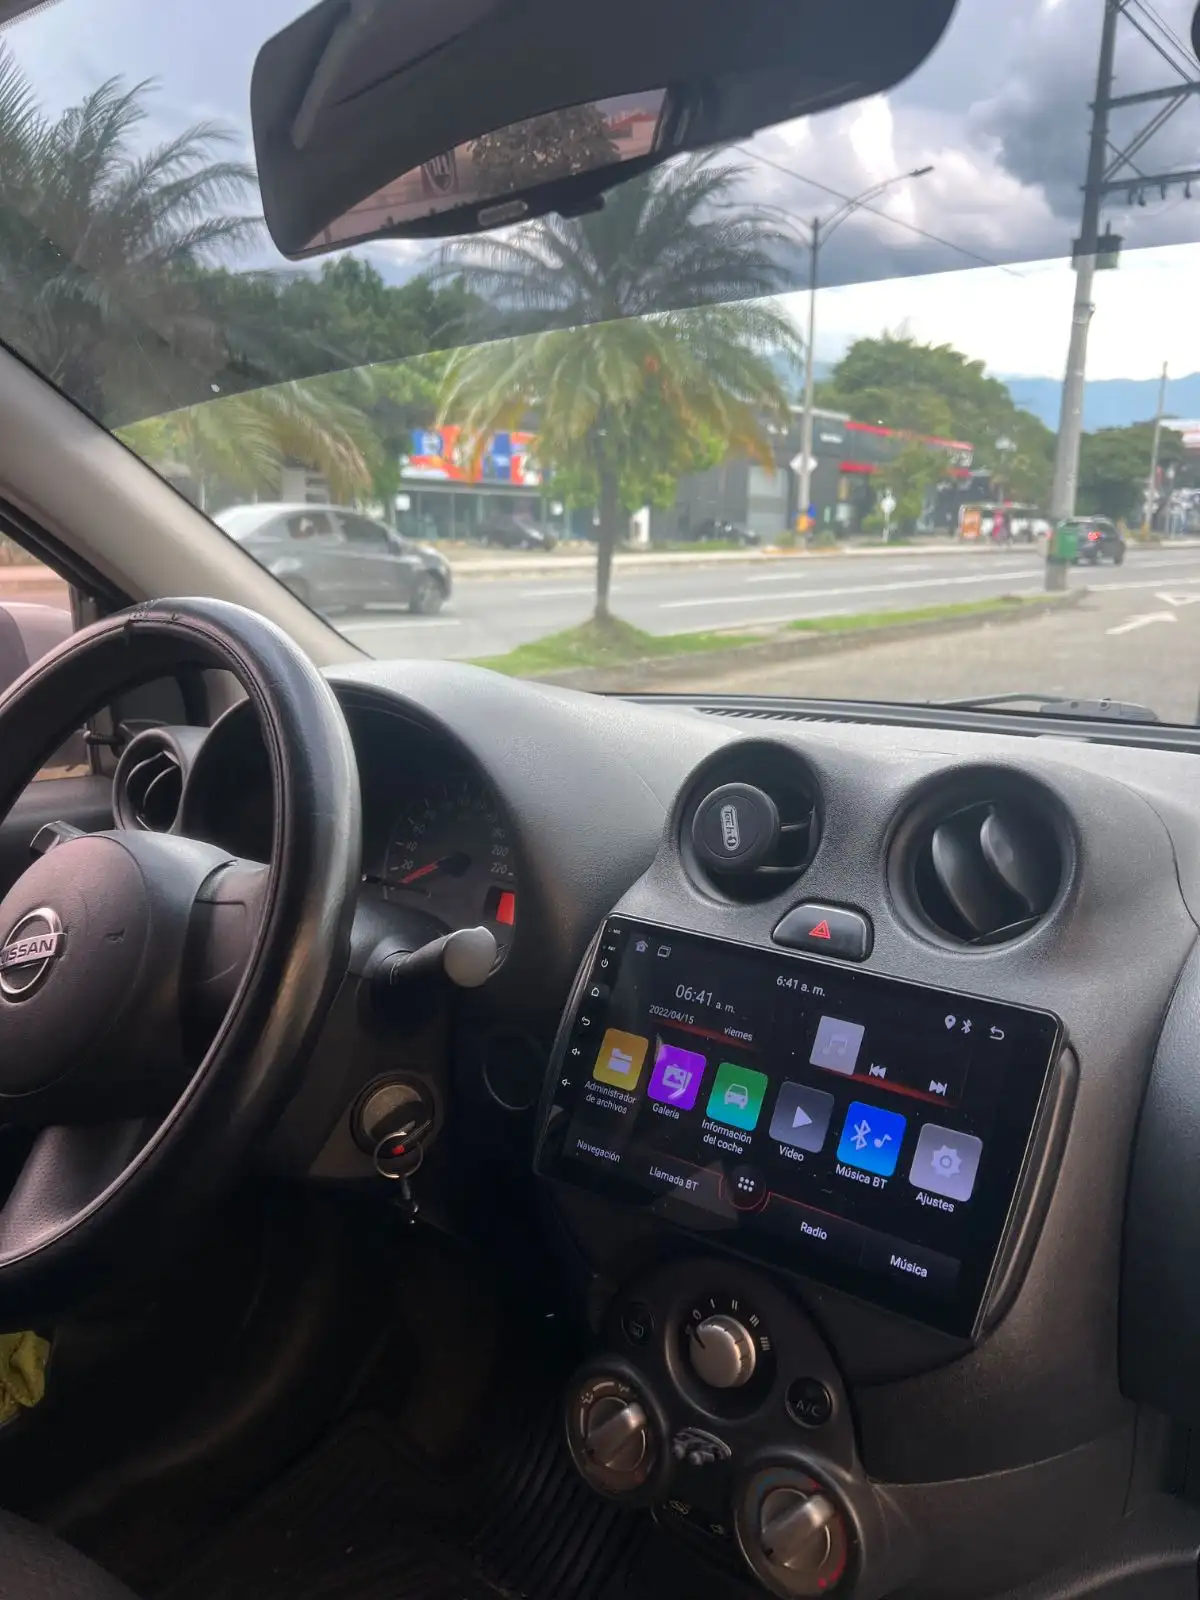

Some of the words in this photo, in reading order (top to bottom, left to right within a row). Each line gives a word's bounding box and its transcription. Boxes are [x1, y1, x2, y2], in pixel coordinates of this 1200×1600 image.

[401, 859, 414, 870] 20
[490, 862, 508, 874] 220
[776, 976, 799, 989] 6:41
[675, 984, 713, 1006] 06:41
[649, 1004, 695, 1025] 2022/04/15
[724, 1026, 753, 1041] viernes
[584, 1081, 636, 1104] Administrador
[585, 1093, 597, 1103] de
[597, 1097, 628, 1114] archivos
[701, 1119, 752, 1144] Información
[576, 1139, 621, 1163] Navegación
[703, 1133, 717, 1145] del
[717, 1138, 743, 1155] coche
[649, 1166, 684, 1187] Llamada
[685, 1178, 699, 1191] BT
[836, 1163, 870, 1185] Música
[872, 1176, 888, 1190] BT
[915, 1191, 955, 1213] Ajustes
[800, 1221, 828, 1240] Radio
[890, 1254, 928, 1278] Música
[796, 1400, 820, 1417] A/C
